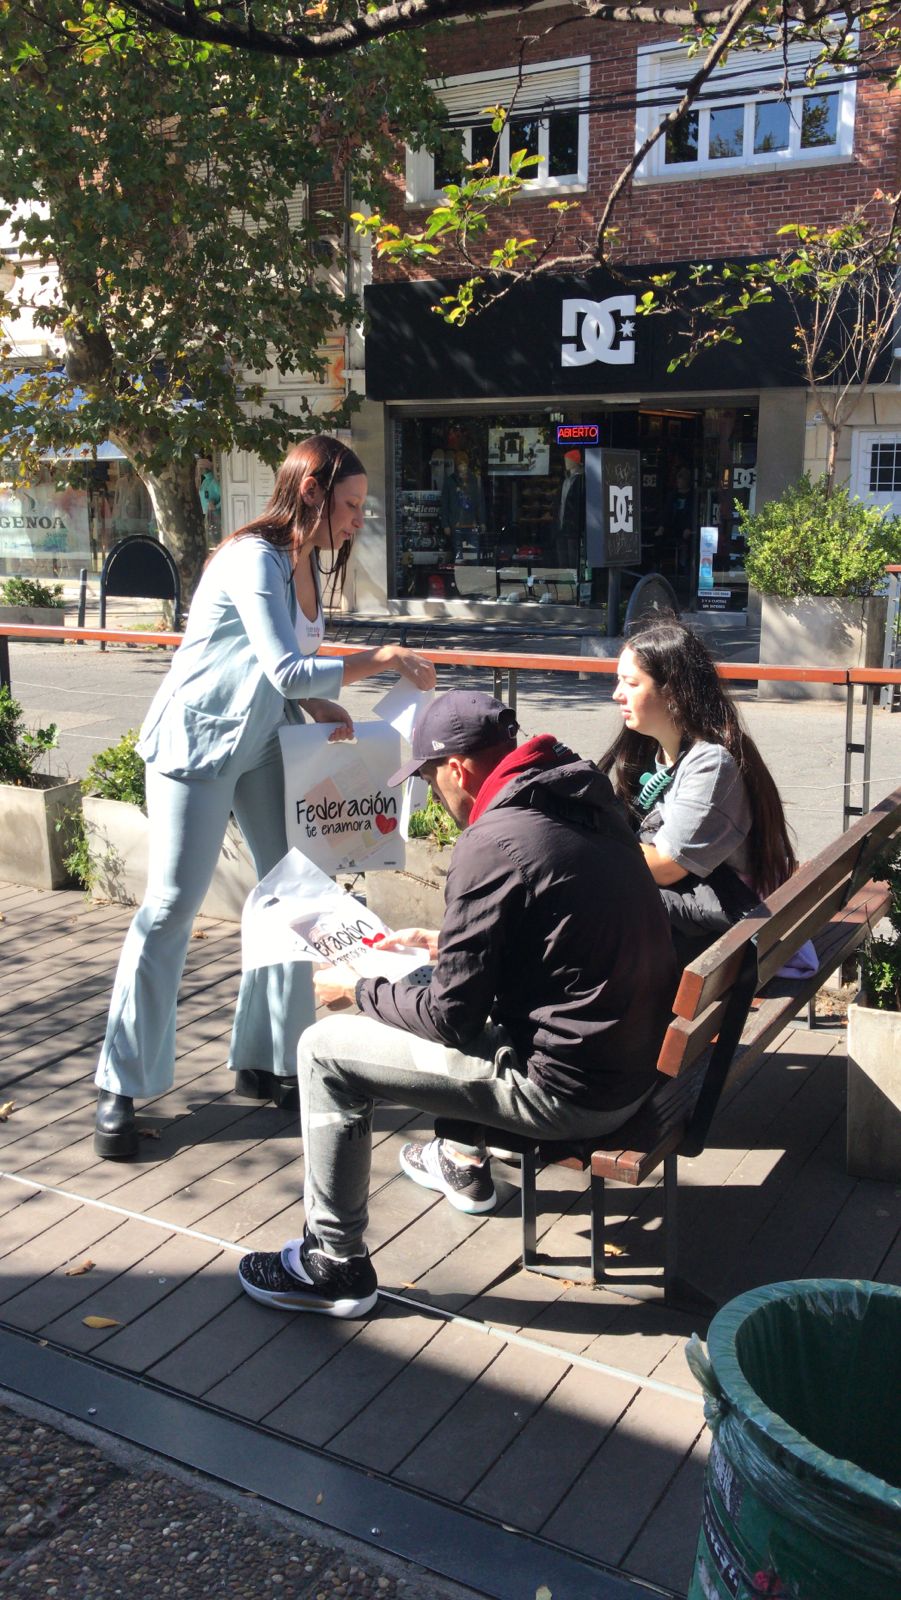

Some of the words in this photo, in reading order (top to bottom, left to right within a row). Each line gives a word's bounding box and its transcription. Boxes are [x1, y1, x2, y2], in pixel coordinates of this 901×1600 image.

[561, 295, 637, 367] DC
[558, 426, 598, 438] ABIERTO
[0, 516, 66, 529] GENOA
[609, 485, 634, 534] DC
[296, 790, 397, 824] Federación
[305, 823, 318, 838] te
[321, 819, 372, 836] enamora
[314, 918, 374, 957] eración
